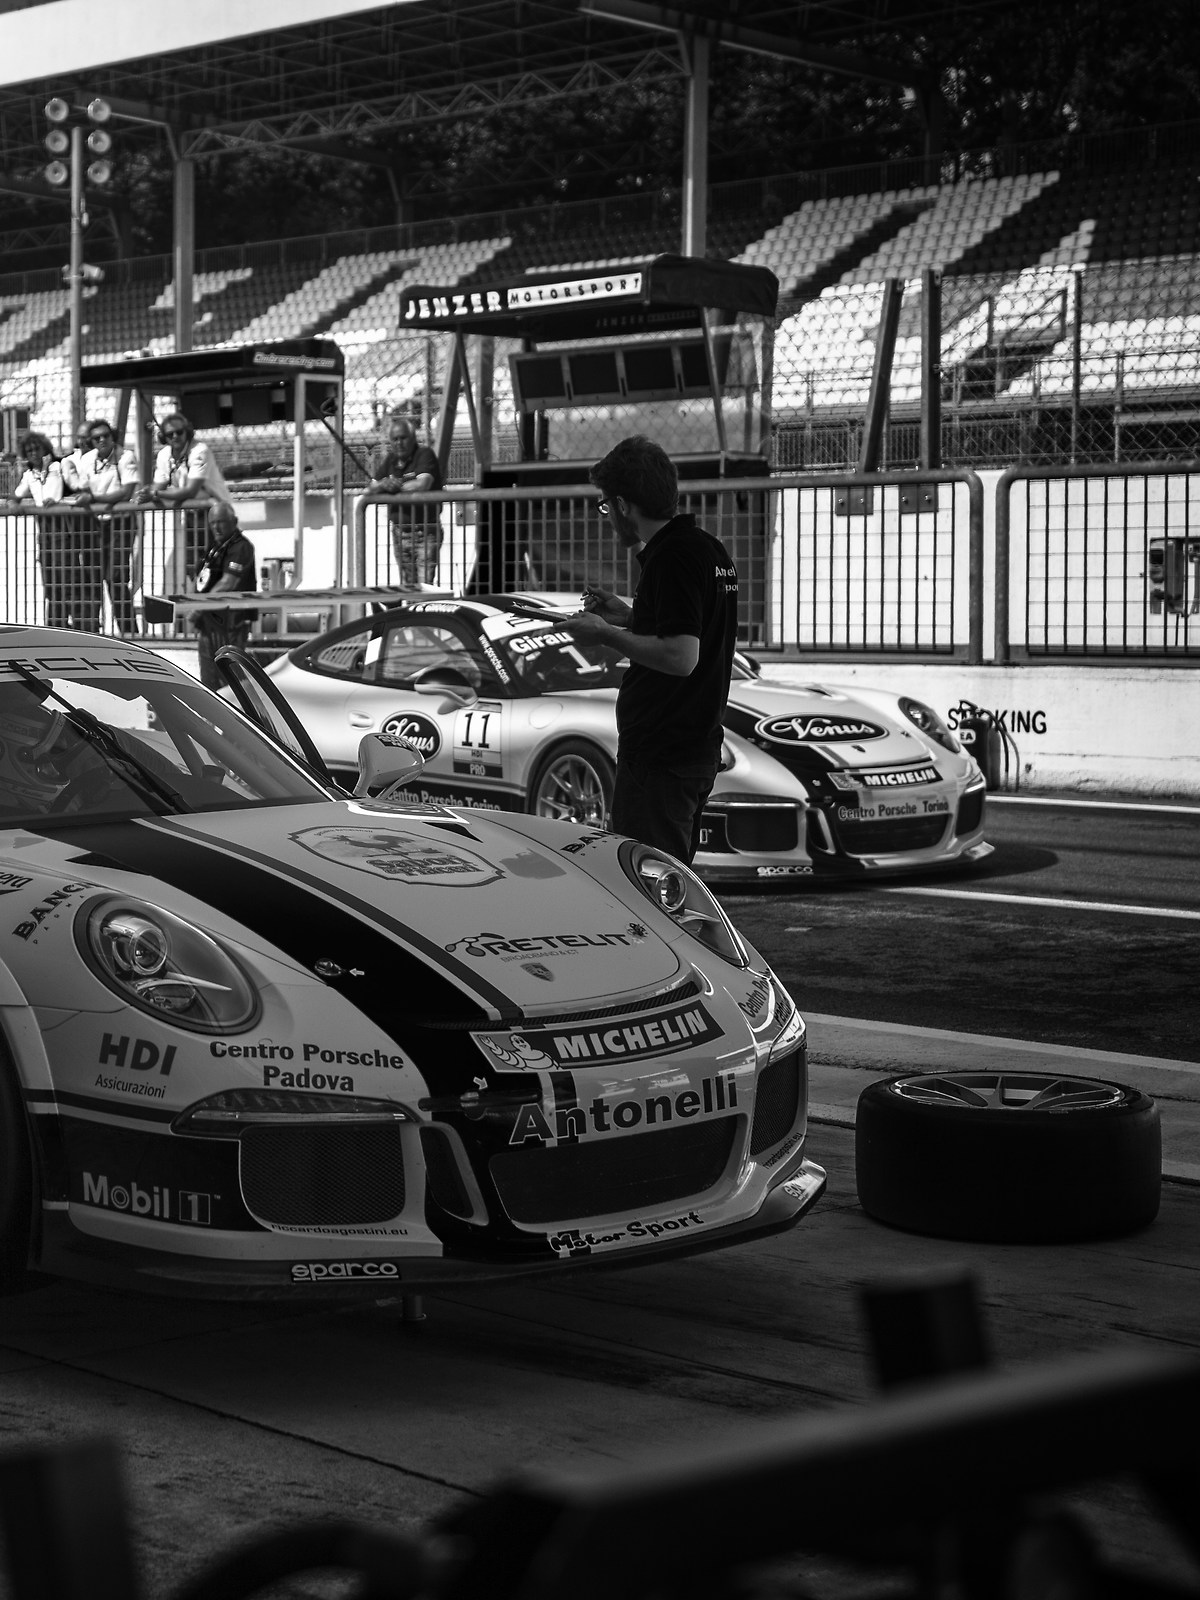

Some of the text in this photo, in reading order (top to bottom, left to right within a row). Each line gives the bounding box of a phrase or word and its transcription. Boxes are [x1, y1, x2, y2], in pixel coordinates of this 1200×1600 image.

[405, 276, 640, 320] JENZER MOTORSPORT
[477, 633, 510, 685] www.porsche.com
[461, 713, 491, 748] 11
[770, 718, 877, 738] Venus
[469, 763, 485, 776] PRO
[864, 767, 937, 787] MICHELIN
[838, 799, 949, 821] Centro Porsche Torino
[756, 865, 813, 878] sparco
[481, 933, 631, 955] RETELIT
[553, 1008, 709, 1059] MICHELIN
[99, 1032, 178, 1076] HDI
[210, 1041, 405, 1069] Centro Porsche
[95, 1073, 166, 1099] Assicurazioni
[263, 1065, 354, 1092] Padova
[508, 1072, 738, 1146] Antonelli
[82, 1171, 170, 1219] Mobil
[271, 1223, 409, 1236] riccardoagostini.eu
[550, 1211, 704, 1251] Motor Sport
[291, 1262, 399, 1281] sparco
